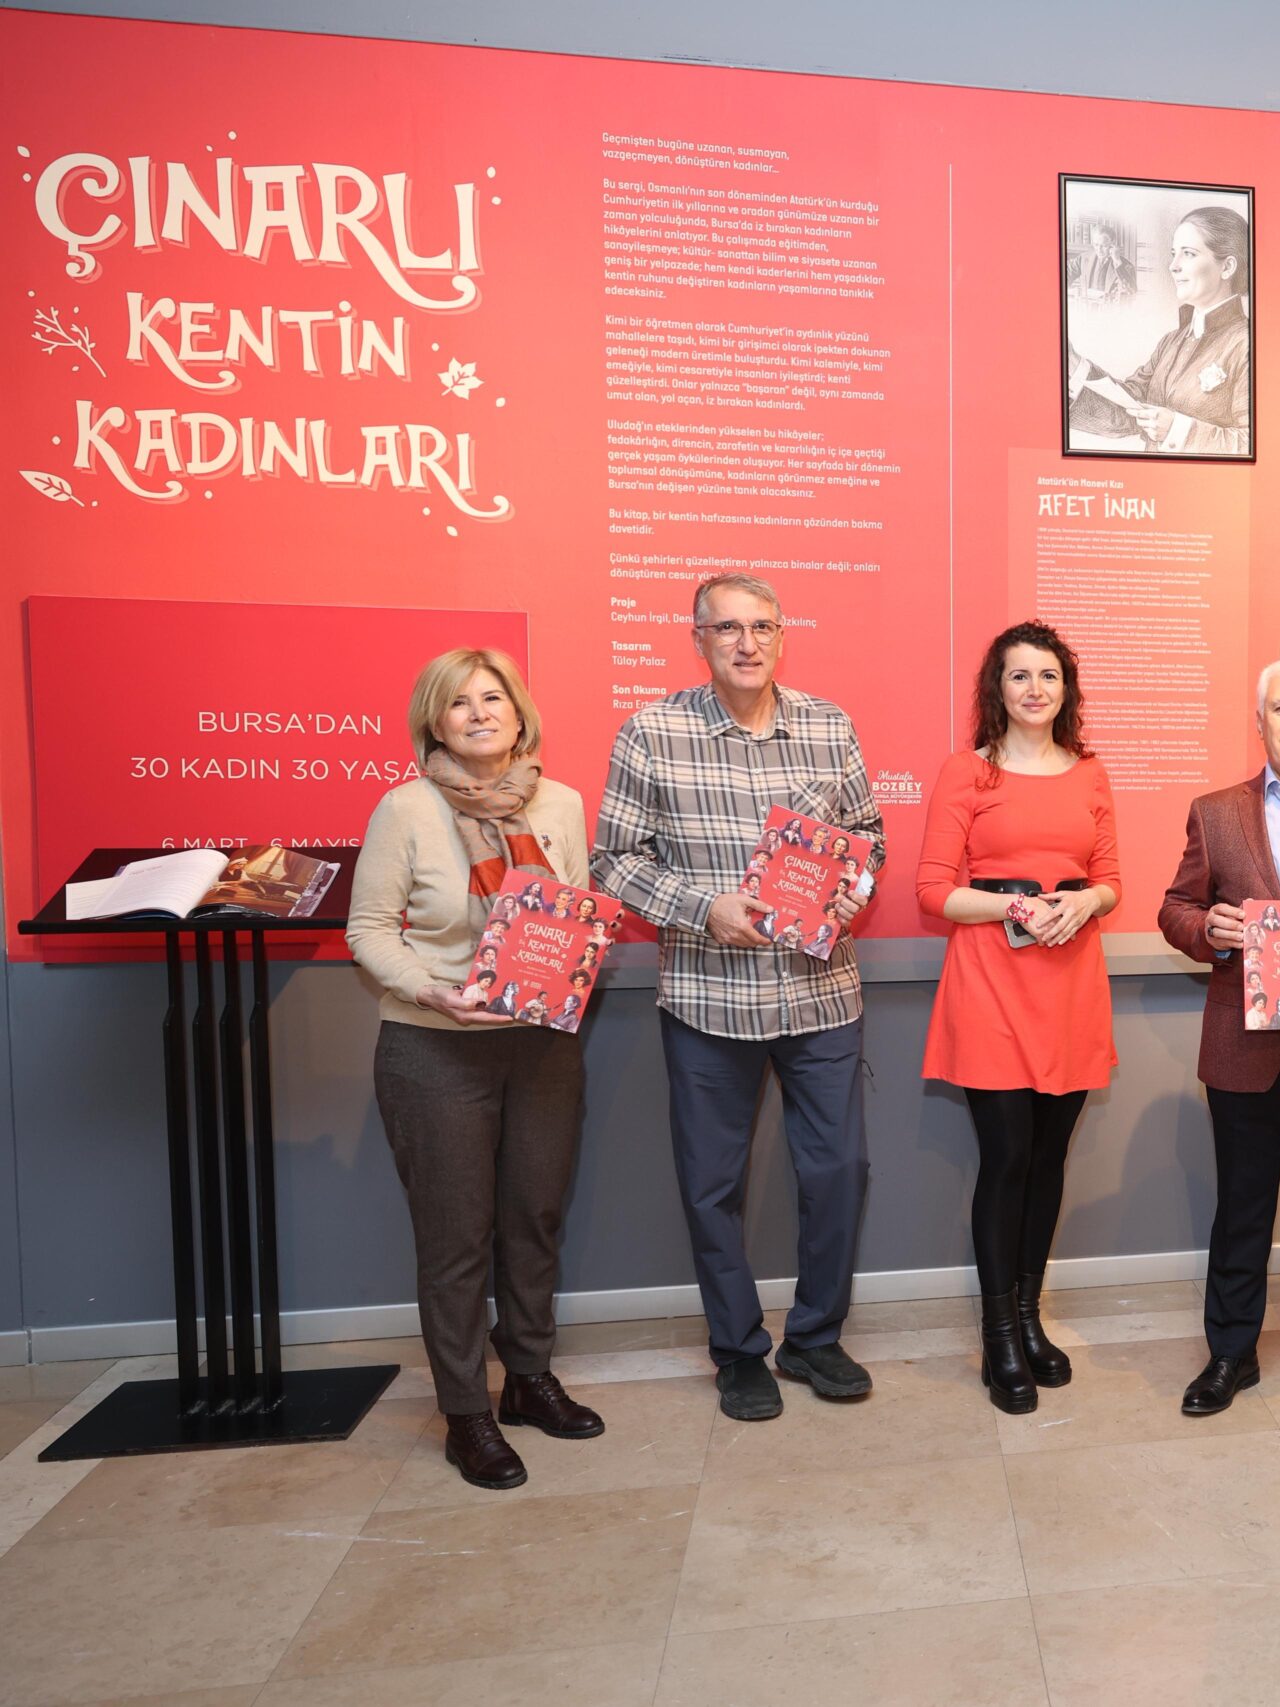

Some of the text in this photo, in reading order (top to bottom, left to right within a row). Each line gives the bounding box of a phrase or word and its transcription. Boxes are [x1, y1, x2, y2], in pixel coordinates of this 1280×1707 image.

[602, 132, 789, 160] Geçmişten bugüne uzanan, susmayan,
[602, 150, 672, 164] vazgeçmeyen,
[675, 155, 731, 168] dönüştüren
[603, 178, 616, 189] Bu
[617, 181, 645, 193] sergi,
[707, 190, 725, 198] son
[727, 189, 787, 204] döneminden
[840, 200, 878, 213] kurduğu
[603, 193, 879, 226] Cumhuriyetin ilk yıllarına ve oradan günümüze uzanan bir
[35, 152, 482, 310] ÇINARLI
[603, 211, 637, 220] zaman
[639, 213, 708, 228] yolculuğunda,
[755, 221, 764, 231] iz
[765, 222, 802, 234] bırakan
[804, 225, 851, 238] kadınların
[664, 230, 709, 243] anlatıyor.
[711, 232, 724, 243] Bu
[726, 235, 776, 247] çalışmada
[778, 239, 828, 252] eğitimden,
[717, 250, 760, 260] sanattan
[762, 251, 786, 263] bilim
[801, 255, 840, 267] siyasete
[842, 260, 877, 269] uzanan
[604, 256, 632, 268] geniş
[634, 256, 648, 267] bir
[704, 262, 726, 272] hem
[728, 264, 754, 275] kendi
[756, 266, 808, 279] kaderlerini
[810, 270, 831, 280] hem
[833, 274, 884, 284] yaşadıkları
[604, 269, 874, 299] kentin ruhunu değiştiren kadınların yaşamlarına tanıklık
[604, 285, 666, 298] edeceksiniz.
[126, 292, 408, 390] KENTİN
[655, 423, 716, 434] eteklerinden
[718, 426, 762, 437] yükselen
[763, 428, 776, 438] bu
[74, 400, 511, 519] KADINLARI
[656, 481, 695, 493] değişen
[696, 484, 732, 494] yüzüne
[733, 486, 758, 495] tanık
[760, 486, 816, 498] olacaksınız.
[1038, 492, 1155, 520] AFET İNAN
[609, 508, 882, 529] Bu kitap, bir kentin hafızasına kadınların gözünden bakma
[609, 523, 654, 534] davetidir.
[609, 553, 640, 564] Çünkü
[642, 554, 683, 566] şehirleri
[685, 556, 747, 568] güzelleştiren
[749, 559, 788, 569] yalnızca
[790, 560, 824, 570] binalar
[853, 562, 880, 572] onları
[610, 568, 666, 580] dönüştüren
[668, 571, 695, 580] cesur
[610, 597, 636, 609] Proje
[610, 611, 646, 623] Ceyhun
[672, 614, 694, 623] Deni
[611, 641, 651, 651] Tasarım
[611, 655, 666, 667] Tülay Palaz
[612, 685, 667, 695] Son Okuma
[130, 757, 421, 784] 30 KADIN 30 YAŞA
[877, 770, 913, 783] Mustafa
[872, 782, 922, 792] BOZBEY
[524, 922, 574, 948] ÇINARLI
